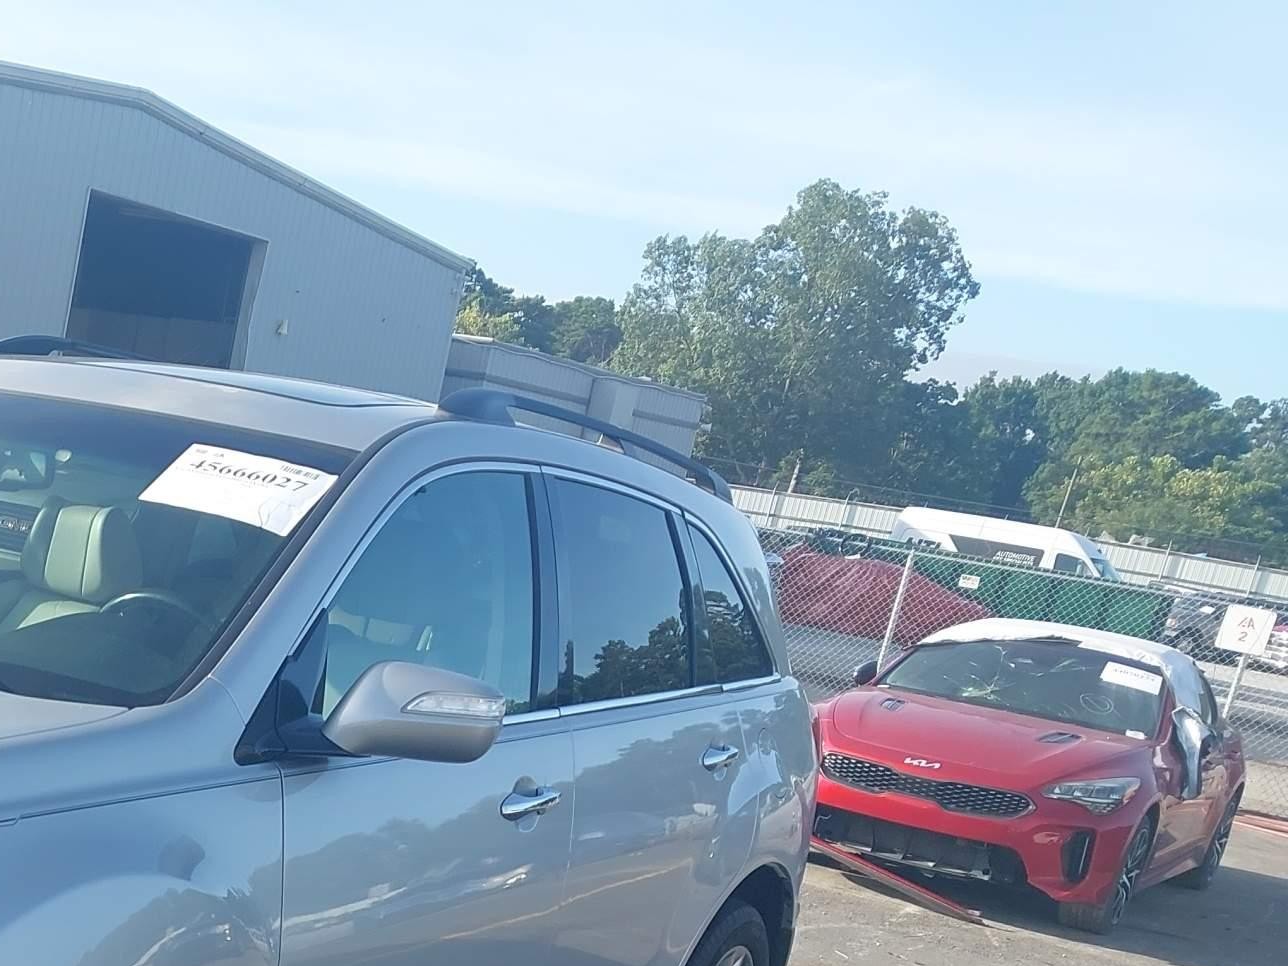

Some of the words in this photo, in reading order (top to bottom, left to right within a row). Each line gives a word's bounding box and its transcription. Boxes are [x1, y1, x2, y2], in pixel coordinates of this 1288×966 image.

[189, 460, 309, 491] 45666027
[992, 550, 1037, 563] AUTOMOTIVE
[1238, 631, 1248, 642] 2
